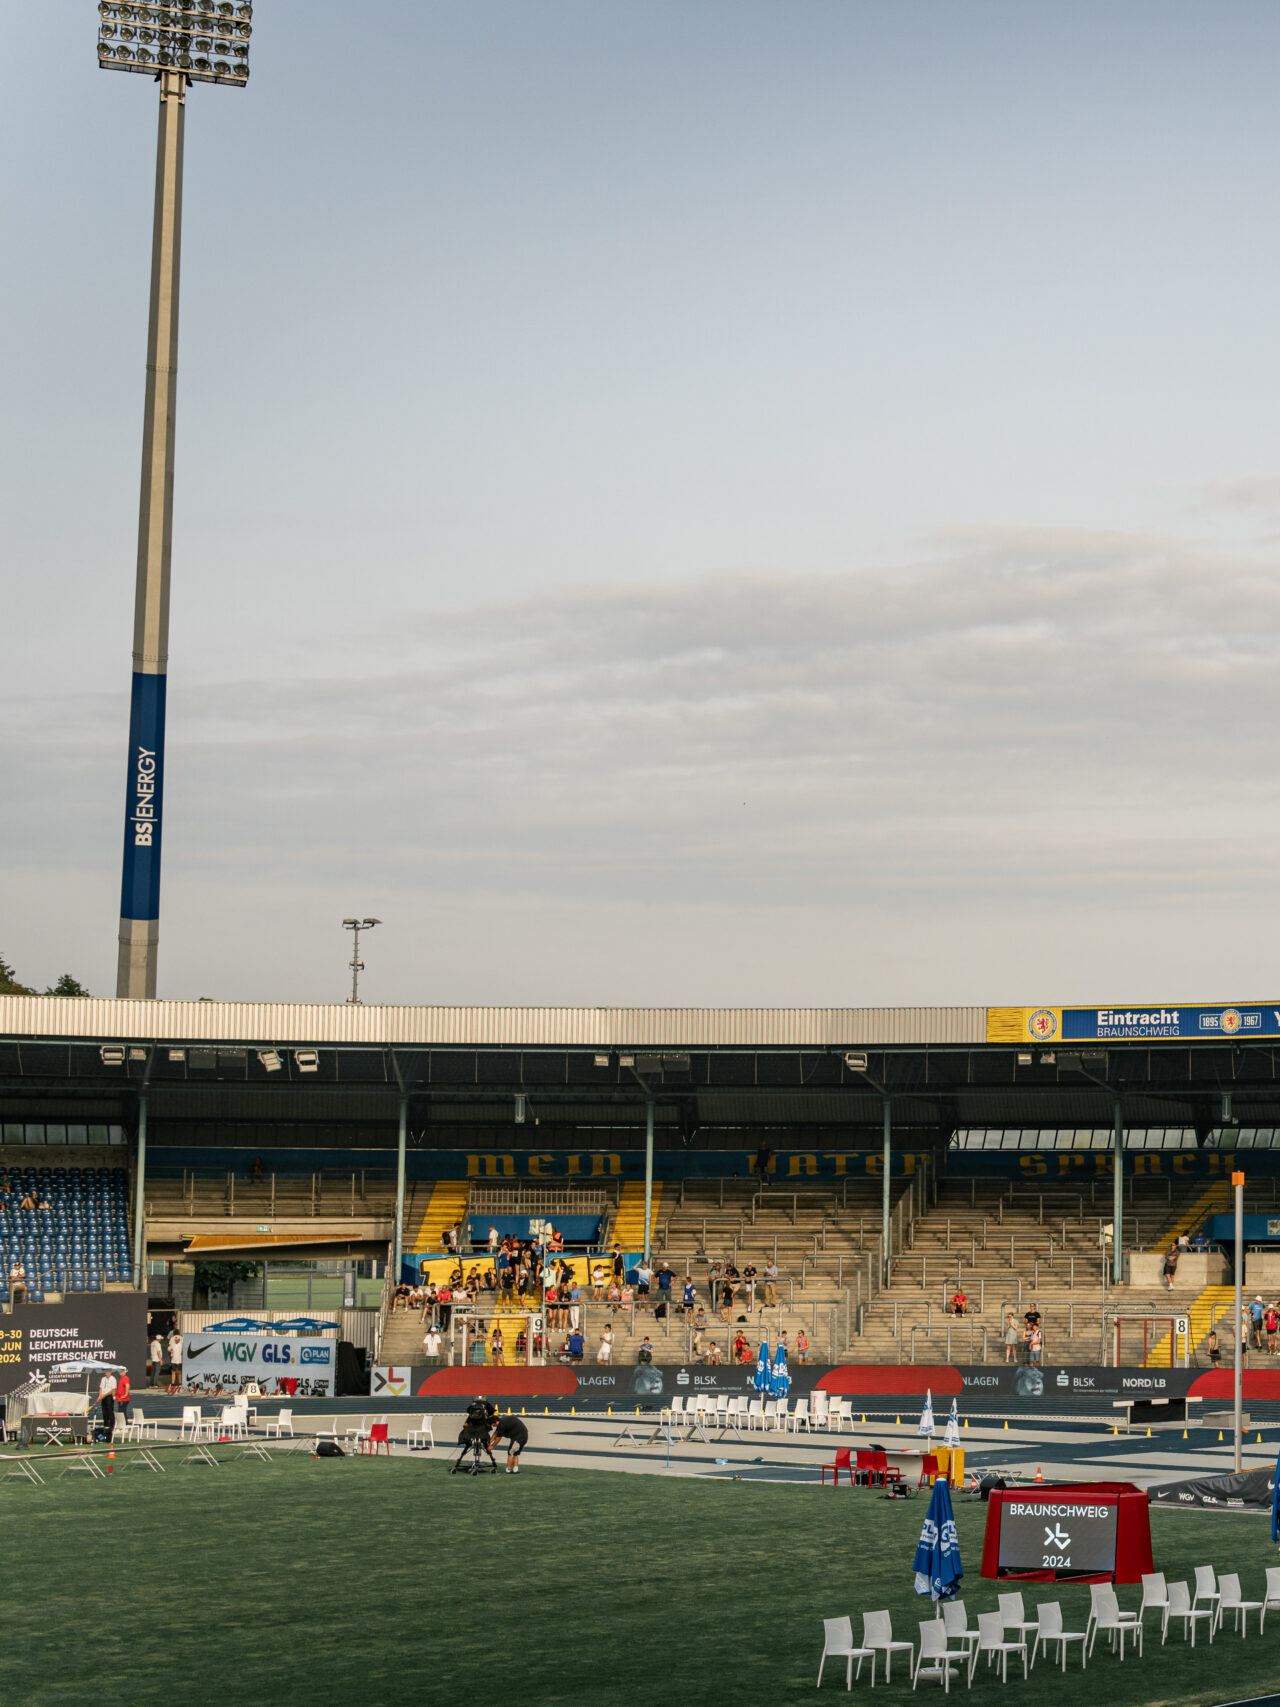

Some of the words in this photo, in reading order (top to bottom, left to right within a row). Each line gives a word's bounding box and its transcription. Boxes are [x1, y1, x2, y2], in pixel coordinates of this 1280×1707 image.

[1097, 1010, 1180, 1026] Eintracht
[1202, 1016, 1219, 1028] 1895
[1243, 1015, 1259, 1027] 1967
[1097, 1026, 1180, 1038] BRAUNSCHWEIG
[534, 1318, 542, 1331] 9
[1178, 1320, 1186, 1334] 8
[30, 1328, 79, 1338] DEUTSCHE
[1, 1342, 22, 1351] JUN
[29, 1340, 104, 1350] LEICHTATHLETIK
[28, 1350, 116, 1362] MEISTERSCHAFTEN
[222, 1342, 257, 1362] WGV
[262, 1344, 295, 1364] GLS.
[204, 1373, 220, 1383] WGV
[223, 1374, 238, 1385] GLS.
[694, 1376, 717, 1385] BLSK
[1073, 1378, 1095, 1387] BLSK
[1122, 1377, 1166, 1389] NORD/LB
[251, 1385, 257, 1393] 8
[1179, 1493, 1194, 1501] WGV
[1010, 1503, 1108, 1518] BRAUNSCHWEIG
[1042, 1554, 1071, 1568] 2024
